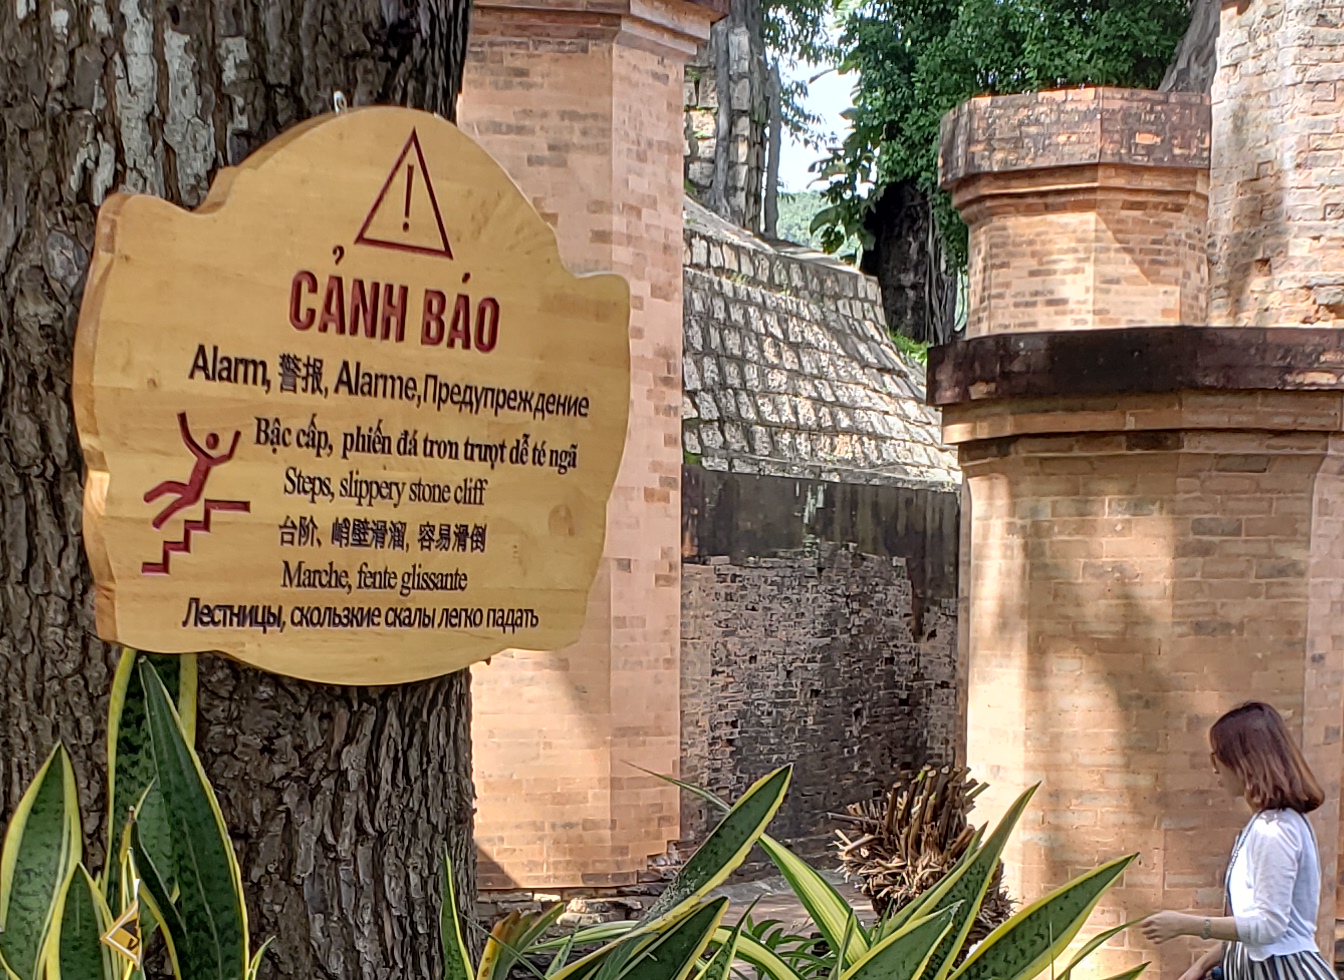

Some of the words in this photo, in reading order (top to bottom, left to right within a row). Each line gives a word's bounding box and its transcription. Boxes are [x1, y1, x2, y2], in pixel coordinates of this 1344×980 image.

[289, 245, 408, 343] CẢNH
[421, 272, 500, 353] BÁO
[188, 343, 271, 395] Alarm,
[254, 416, 292, 454] Bậc
[296, 413, 333, 458] cấp,
[341, 418, 392, 460] phiến
[397, 429, 418, 457] đá
[509, 433, 530, 466] dễ
[532, 440, 546, 467] té
[549, 444, 578, 475] ngã
[284, 466, 334, 504] Steps,
[339, 469, 406, 508] slippery
[409, 477, 451, 503] stone
[454, 477, 488, 505] cliff
[281, 560, 352, 594] Marche,
[356, 562, 398, 590] fente
[400, 563, 468, 596] glissante
[181, 597, 286, 634] Лестницы,
[290, 605, 382, 628] скользкие
[384, 607, 436, 629] скалы
[437, 607, 483, 628] легко
[486, 608, 539, 634] падать
